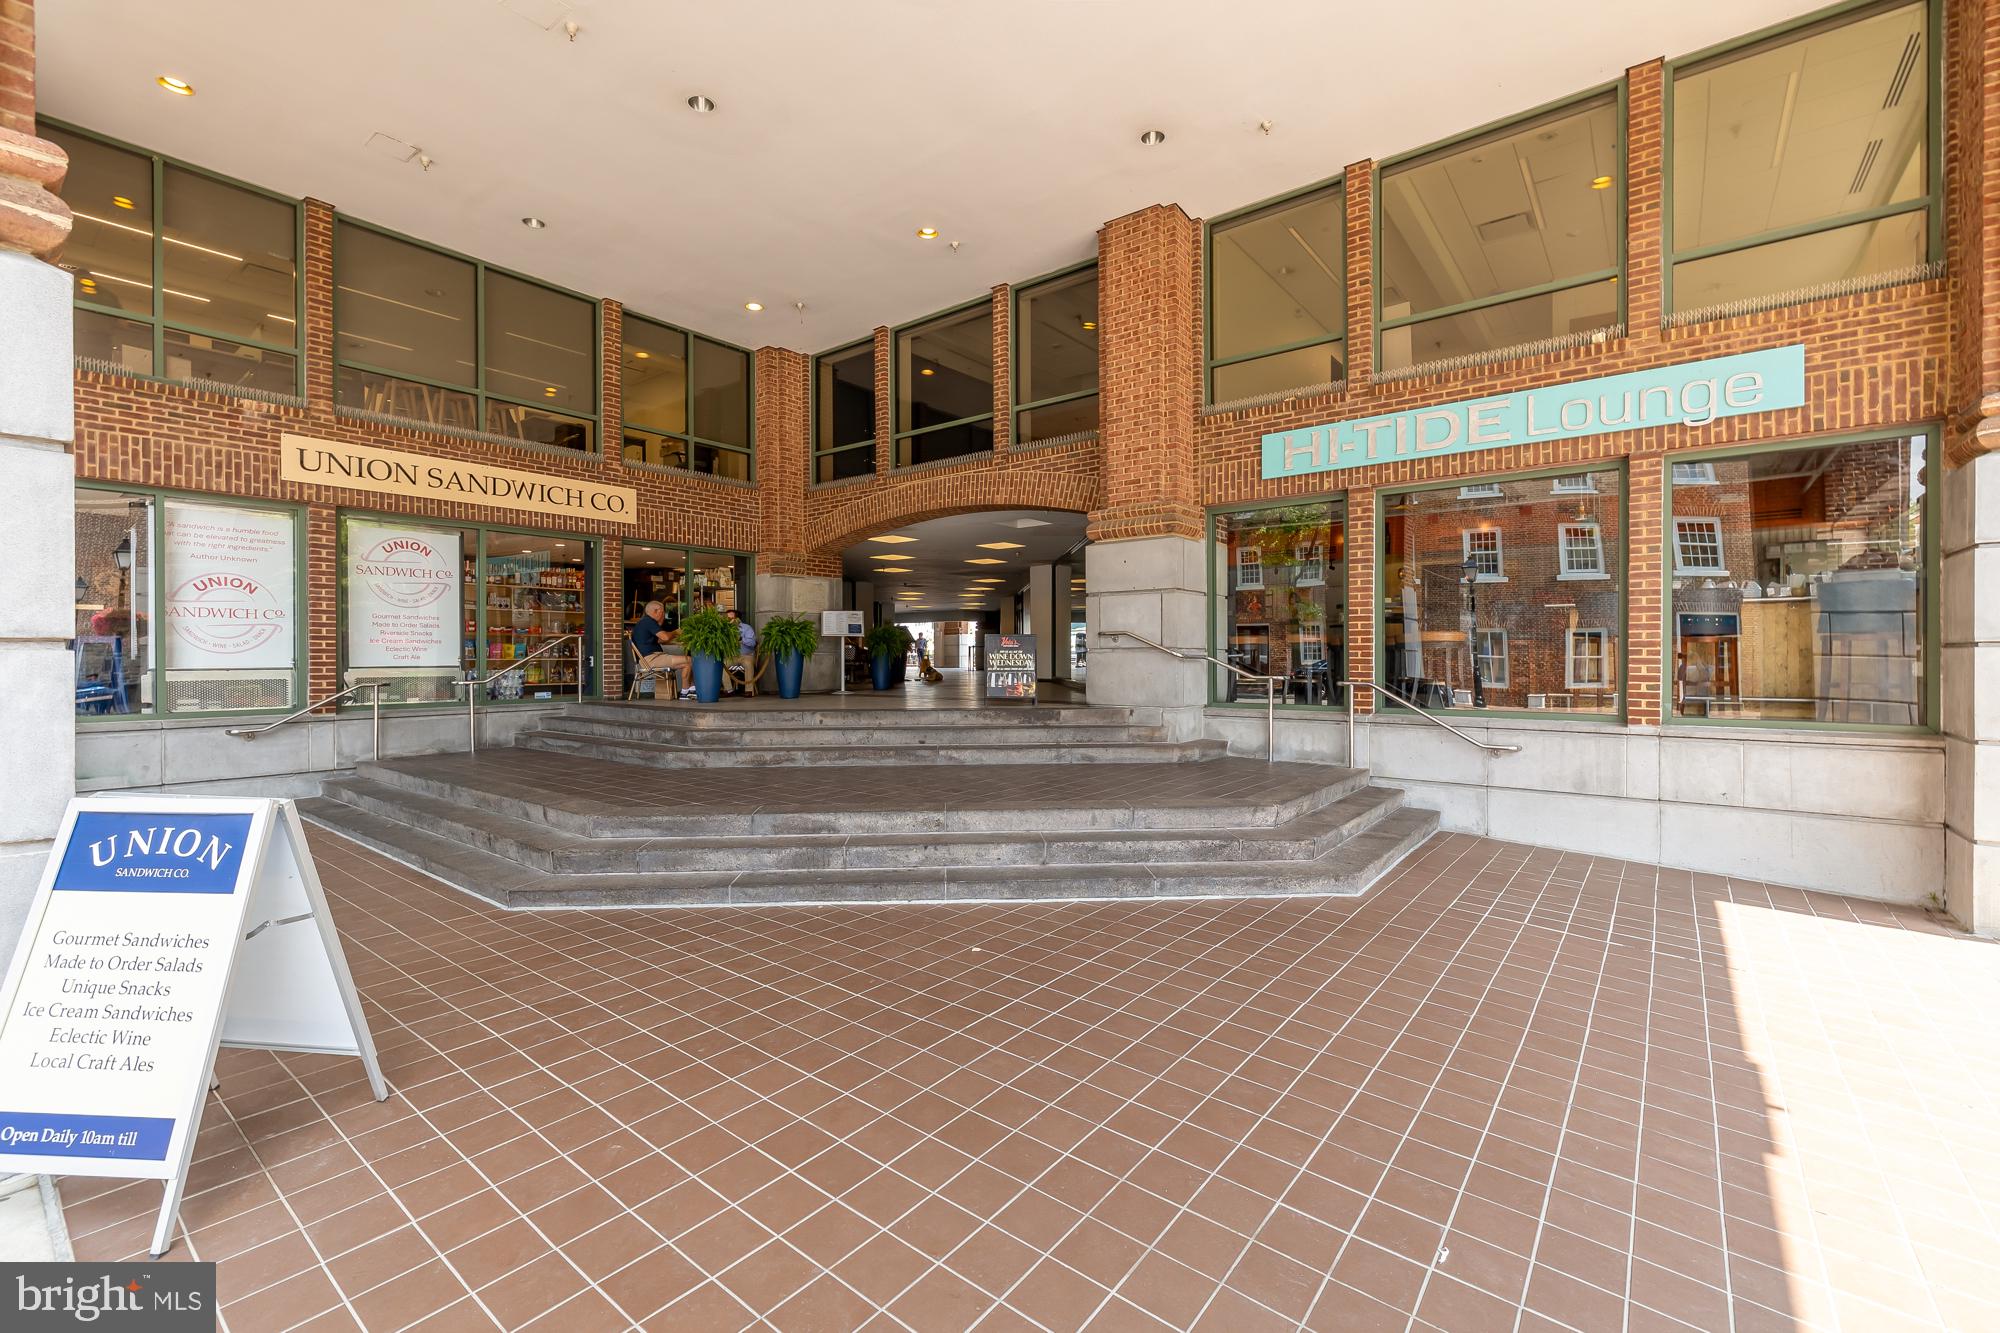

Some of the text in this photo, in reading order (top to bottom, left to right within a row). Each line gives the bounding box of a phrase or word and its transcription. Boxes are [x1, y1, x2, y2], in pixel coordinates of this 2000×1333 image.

[1284, 372, 1764, 471] HI-TIDE Lounge
[296, 447, 630, 514] UNION SANDWICH CO.
[176, 522, 215, 531] sandwich
[232, 527, 261, 535] humble
[206, 534, 239, 542] elevated
[249, 538, 286, 546] greatness
[382, 540, 433, 557] UNION
[190, 553, 258, 563] Author Unknown
[356, 564, 432, 579] SANDWICH
[193, 576, 258, 595] UNION
[89, 827, 232, 871] UNION
[115, 867, 190, 878] SANDWICH CO.
[53, 930, 210, 949] Gourmet Sandwiches
[44, 954, 203, 973] Made to Order Salads
[61, 979, 171, 999] Unique Snacks
[23, 1002, 193, 1022] Ice Cream Sandwiches
[49, 1027, 151, 1046] Eclectic Wine
[30, 1052, 155, 1073] Local Craft Ales
[1, 1127, 138, 1148] Open Daily 10am till
